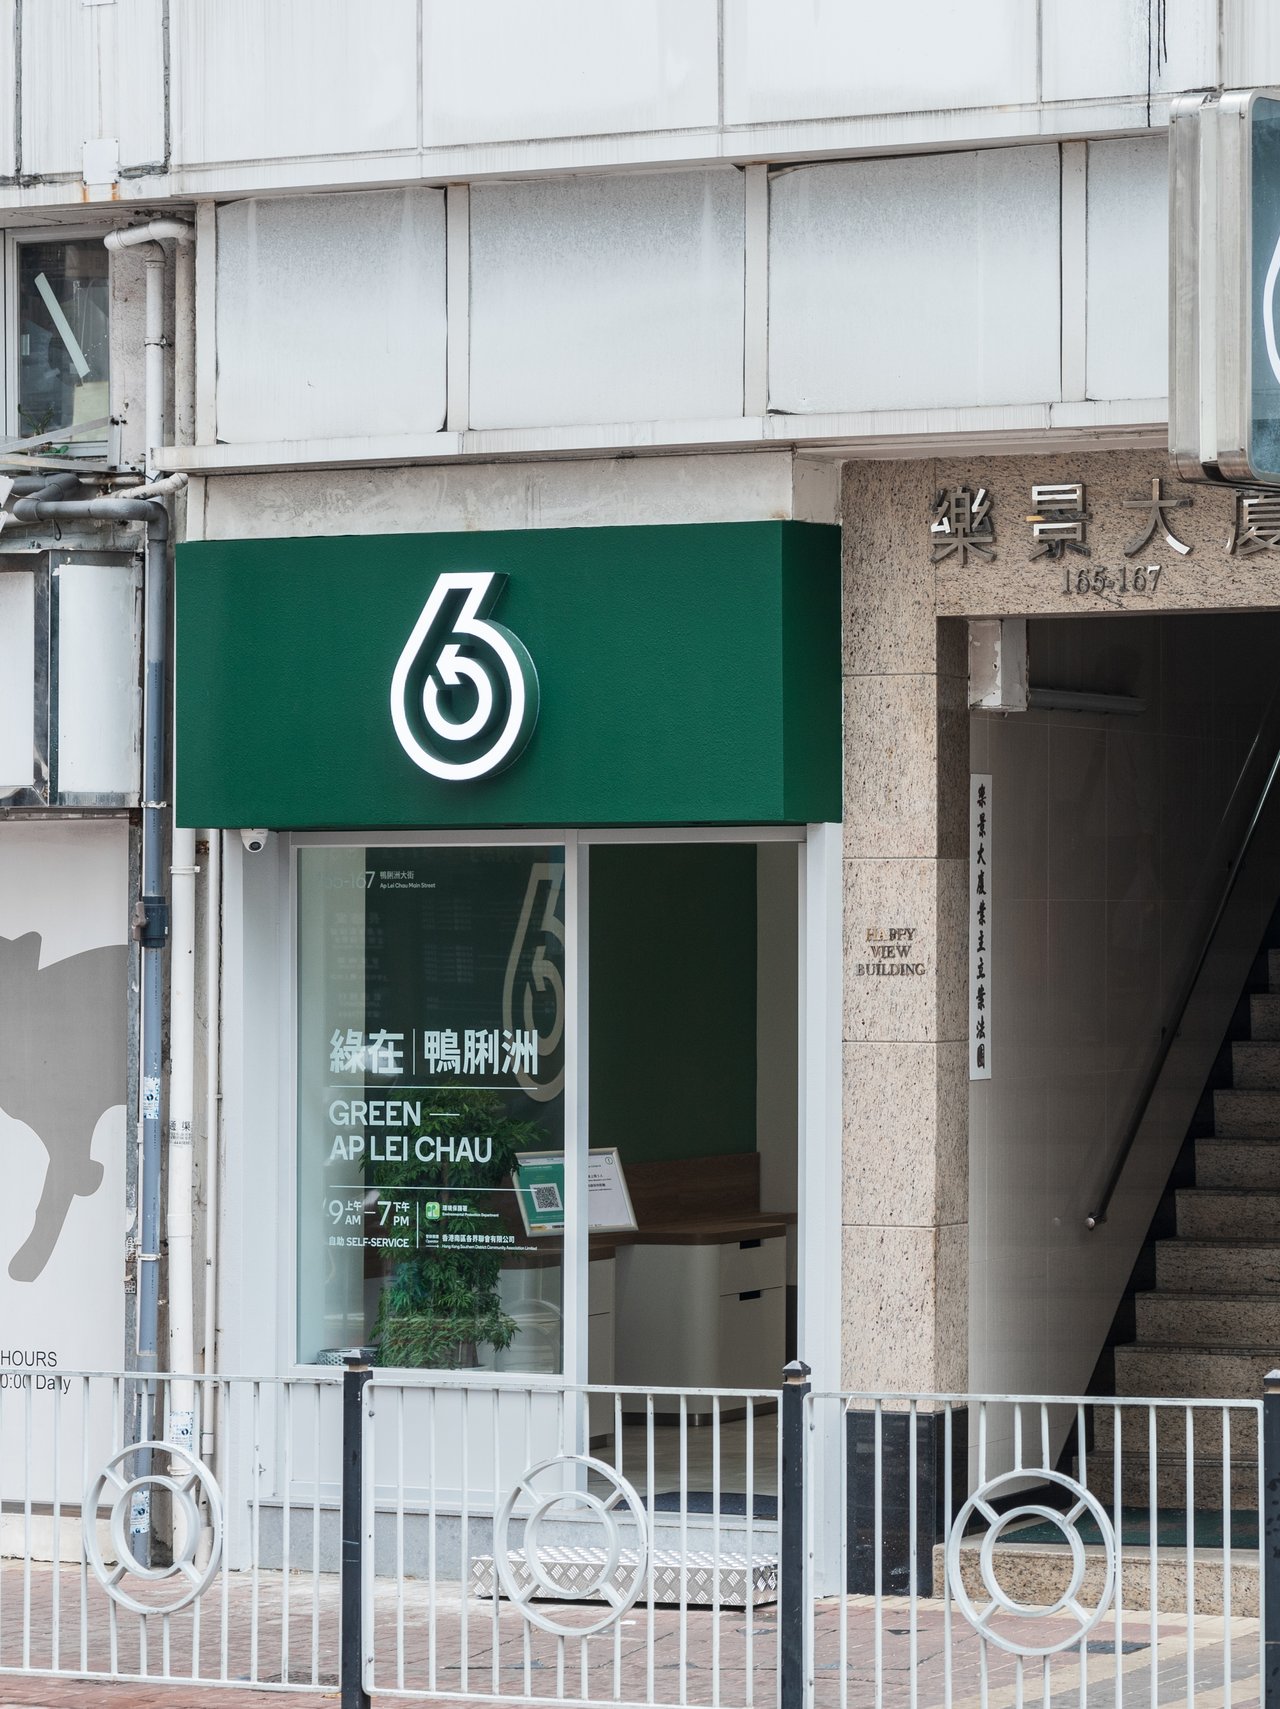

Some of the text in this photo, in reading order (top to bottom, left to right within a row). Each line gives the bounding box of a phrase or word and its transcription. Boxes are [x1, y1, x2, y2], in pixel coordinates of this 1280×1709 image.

[1061, 564, 1162, 595] 165-167
[379, 870, 415, 880] 鴨脷洲大街
[870, 945, 912, 959] VIEW
[856, 963, 926, 977] BUILDING
[329, 1028, 538, 1075] 綠在 鴨脷洲
[328, 1099, 421, 1127] GREEN
[329, 1135, 493, 1163] AP LEI CHAU
[328, 1199, 410, 1227] 9 上午 7 下午
[344, 1215, 410, 1227] AM PM
[328, 1235, 410, 1249] 自助 SELF-SERVICE
[0, 1349, 58, 1368] HOURS
[36, 1374, 72, 1395] Daly
